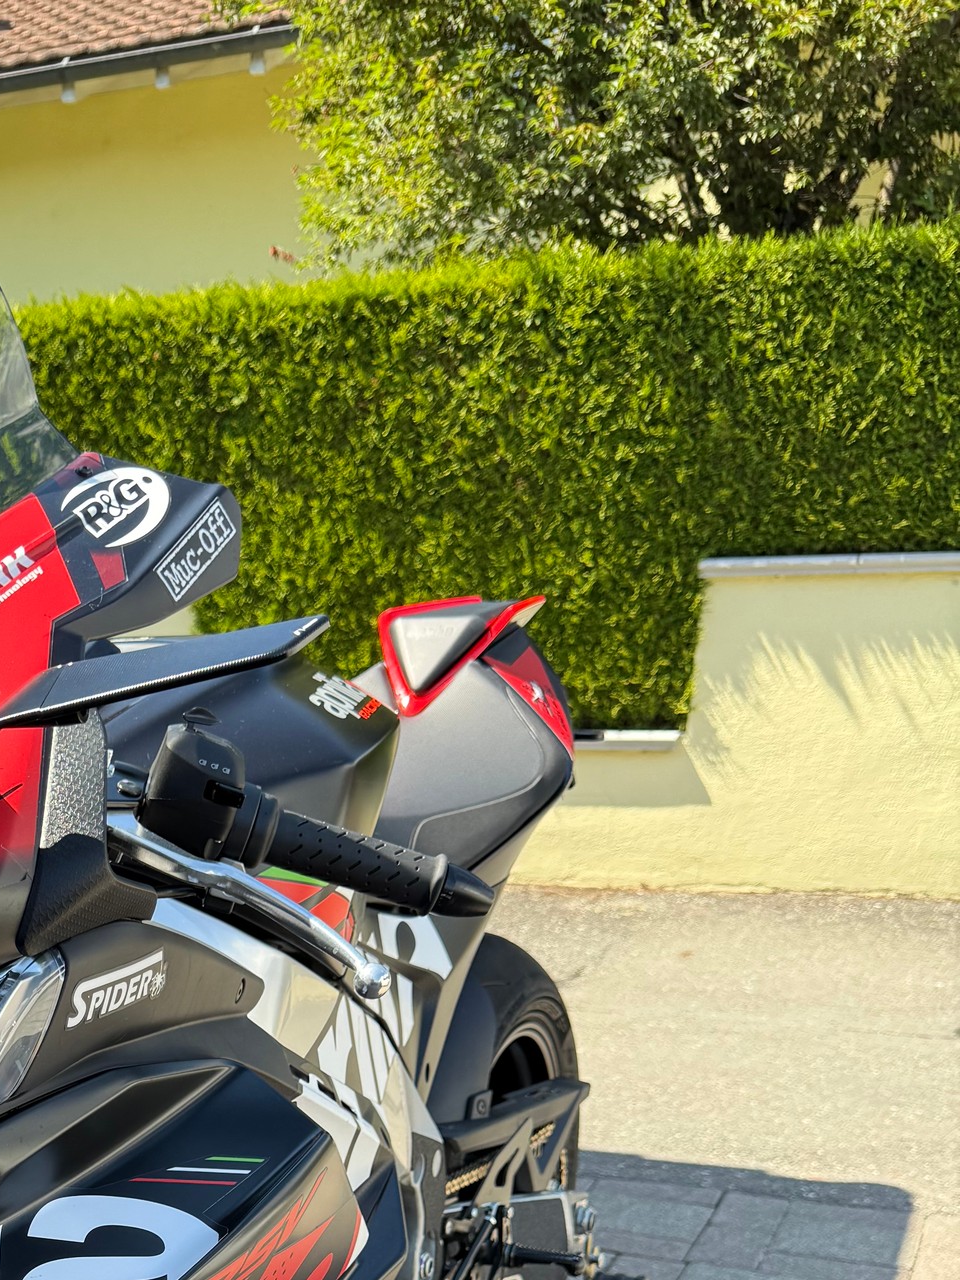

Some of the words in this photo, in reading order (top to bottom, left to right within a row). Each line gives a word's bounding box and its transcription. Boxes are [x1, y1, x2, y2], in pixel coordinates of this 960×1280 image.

[81, 477, 146, 535] R&G
[164, 511, 232, 593] Muc-Off
[66, 950, 166, 1031] SPIDER
